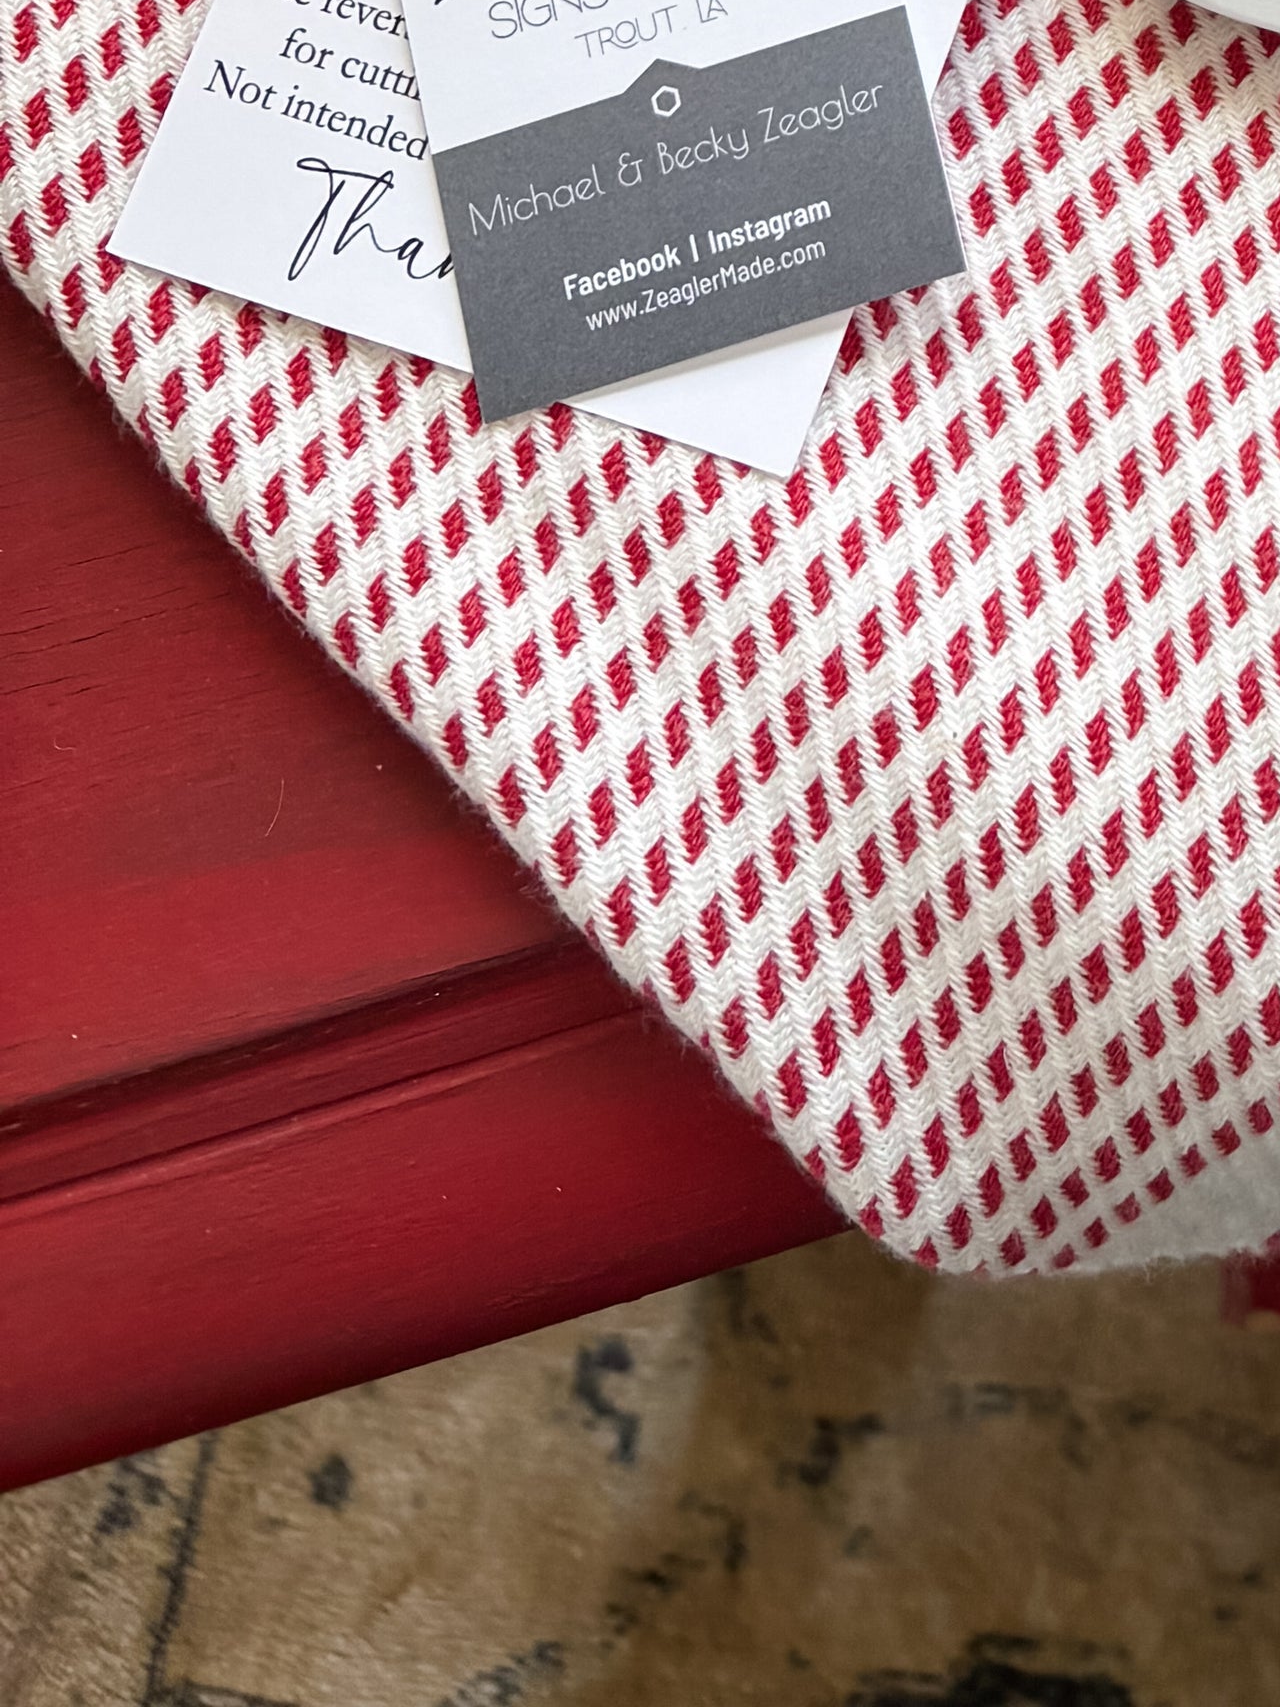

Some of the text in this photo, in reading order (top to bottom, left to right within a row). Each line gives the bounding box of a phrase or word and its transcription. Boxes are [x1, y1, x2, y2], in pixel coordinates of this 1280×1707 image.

[279, 27, 335, 71] for
[203, 59, 429, 162] Not intended
[468, 84, 884, 236] Michael & Becky Zeagler
[563, 243, 682, 301] Facebook
[707, 198, 832, 256] Instagram
[585, 238, 827, 331] www.ZeaglerMade.com
